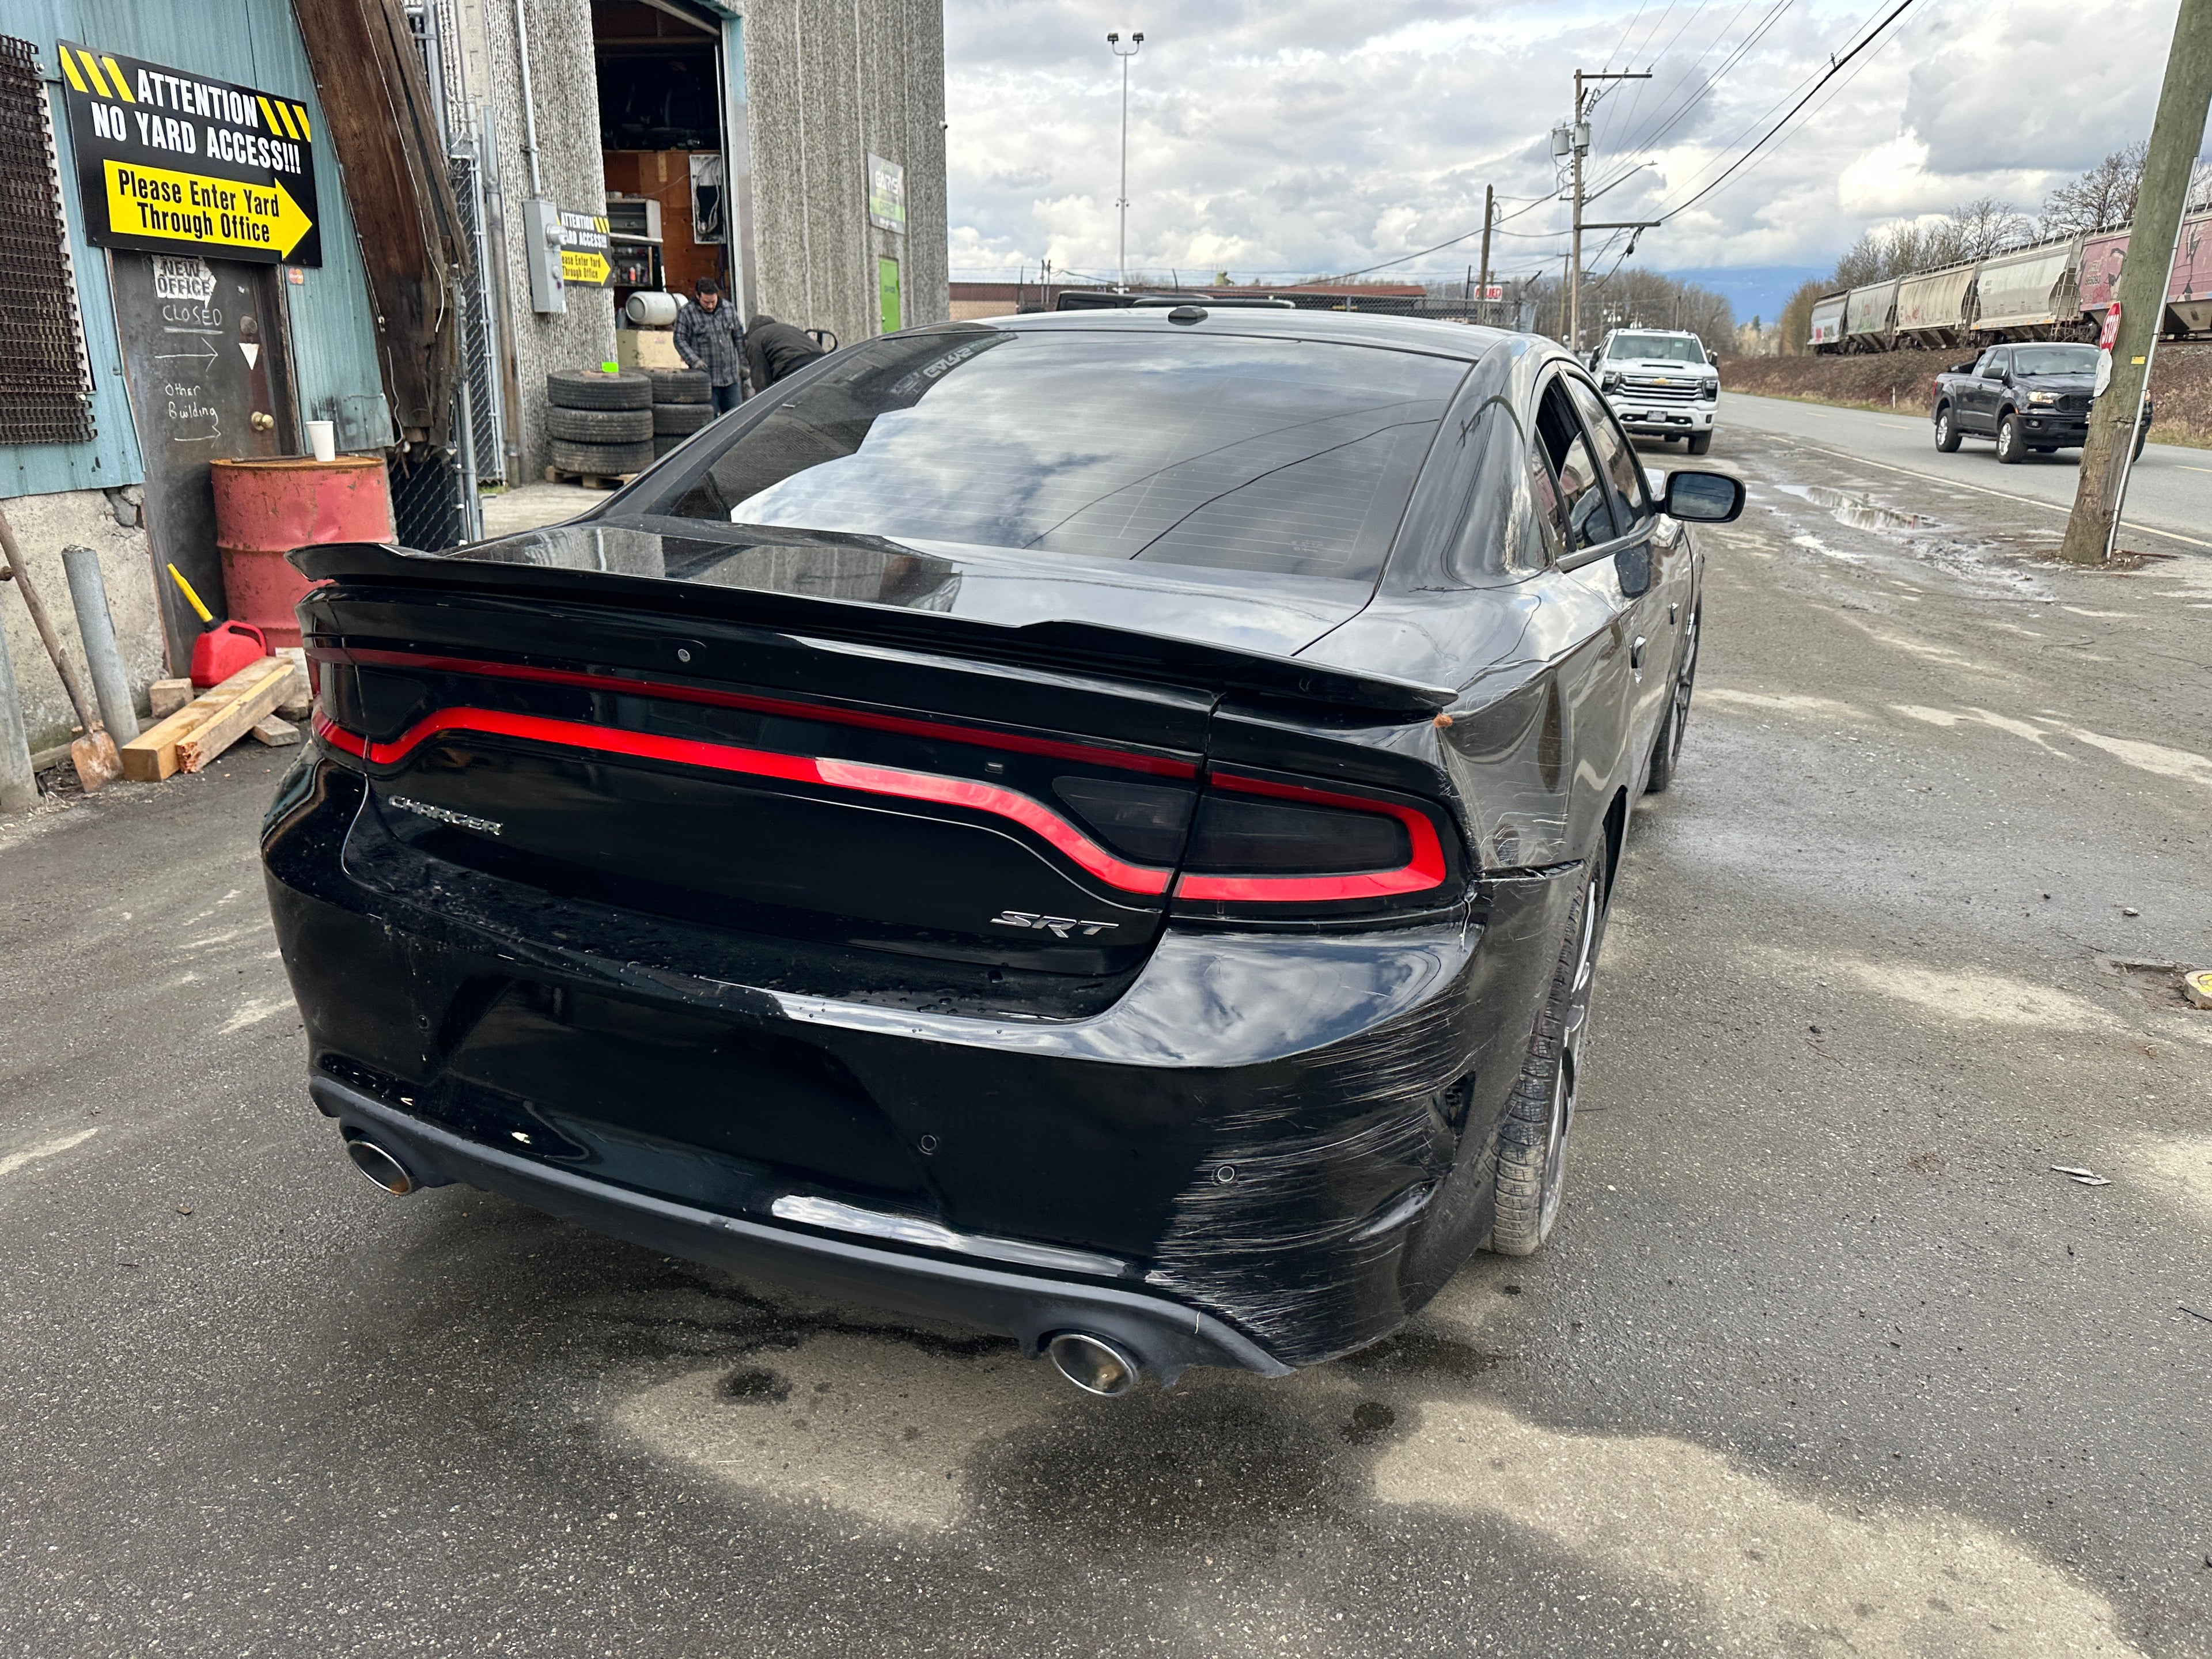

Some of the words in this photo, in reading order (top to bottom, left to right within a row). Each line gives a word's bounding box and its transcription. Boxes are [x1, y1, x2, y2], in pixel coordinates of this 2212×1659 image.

[137, 69, 259, 128] ATTENTION
[91, 101, 127, 142] NO
[134, 111, 196, 154] YARD
[206, 126, 301, 174] ACCESS!!!
[118, 169, 182, 204] Please
[190, 180, 236, 211] Enter
[243, 188, 280, 218] Yard
[137, 202, 214, 239] Through
[221, 213, 270, 243] Office
[560, 211, 594, 231] ATTENTION
[566, 230, 578, 245] ARD
[161, 258, 200, 277] NEW
[562, 255, 574, 265] ease
[575, 255, 588, 266] Enter
[589, 256, 601, 268] Yard
[562, 266, 582, 279] Through
[584, 267, 599, 279] Office
[157, 275, 211, 296] OFFICE
[1475, 288, 1502, 298] ALIED
[162, 304, 222, 326] CLOSED
[2101, 313, 2120, 344] STOP
[165, 382, 202, 397] Other
[168, 401, 219, 426] Building
[990, 910, 1119, 938] SRT
